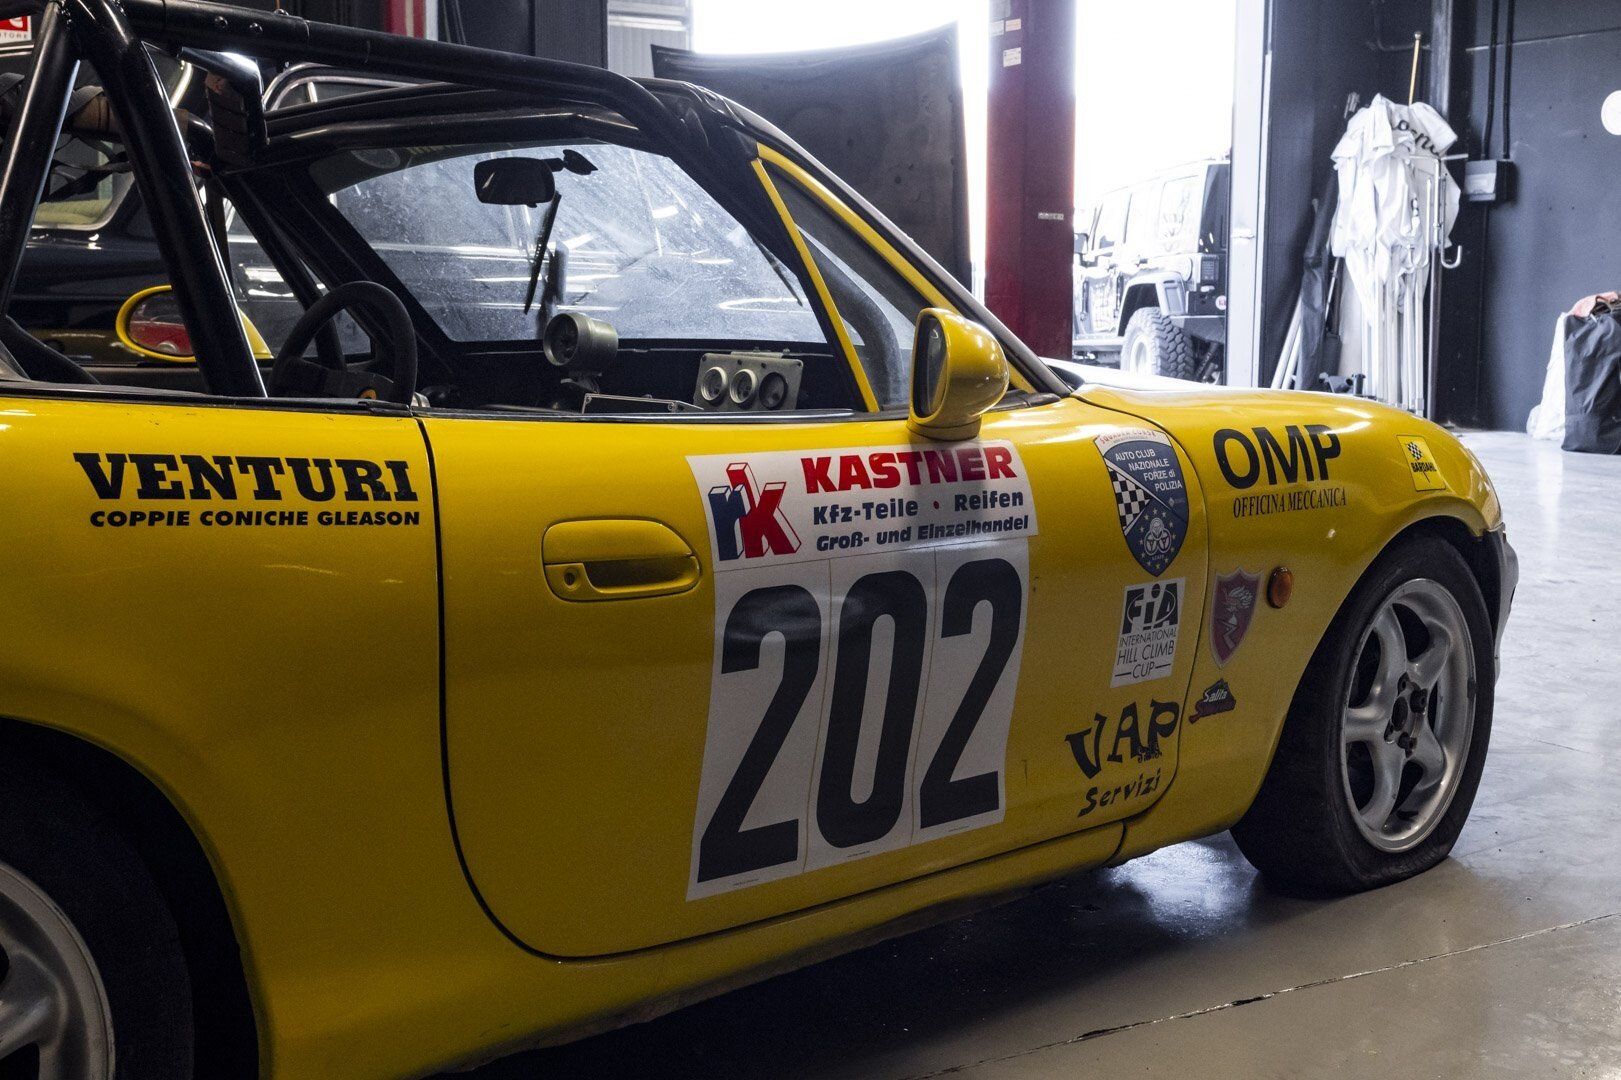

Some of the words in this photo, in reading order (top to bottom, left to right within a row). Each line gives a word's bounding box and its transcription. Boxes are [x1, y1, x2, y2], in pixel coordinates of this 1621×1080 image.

[801, 446, 1018, 494] KASTNER
[1115, 451, 1135, 462] AUTO
[1135, 448, 1156, 459] CLUB
[1128, 458, 1170, 471] NAZIONALE
[1213, 424, 1341, 490] OMP
[73, 452, 419, 502] VENTURI
[1143, 470, 1168, 481] FORZE
[1168, 468, 1176, 478] di
[1154, 480, 1183, 492] POLIZIA
[813, 498, 919, 525] Kfz-Teile
[954, 490, 1024, 512] Reifen
[1233, 493, 1286, 518] OFFICINA
[1287, 487, 1347, 512] MECCANICA
[90, 510, 190, 527] COPPIE
[200, 510, 308, 527] CONICHE
[317, 511, 420, 526] GLEASON
[876, 526, 911, 545] und
[917, 515, 1029, 540] Einzelhandel
[1120, 627, 1177, 647] INTERNATIONAL
[1117, 645, 1138, 666] HILL
[1141, 640, 1175, 661] CLIMB
[1132, 661, 1155, 679] CUP
[697, 558, 1022, 883] 202
[1064, 698, 1180, 779] VAP
[1077, 767, 1161, 817] Servizi
